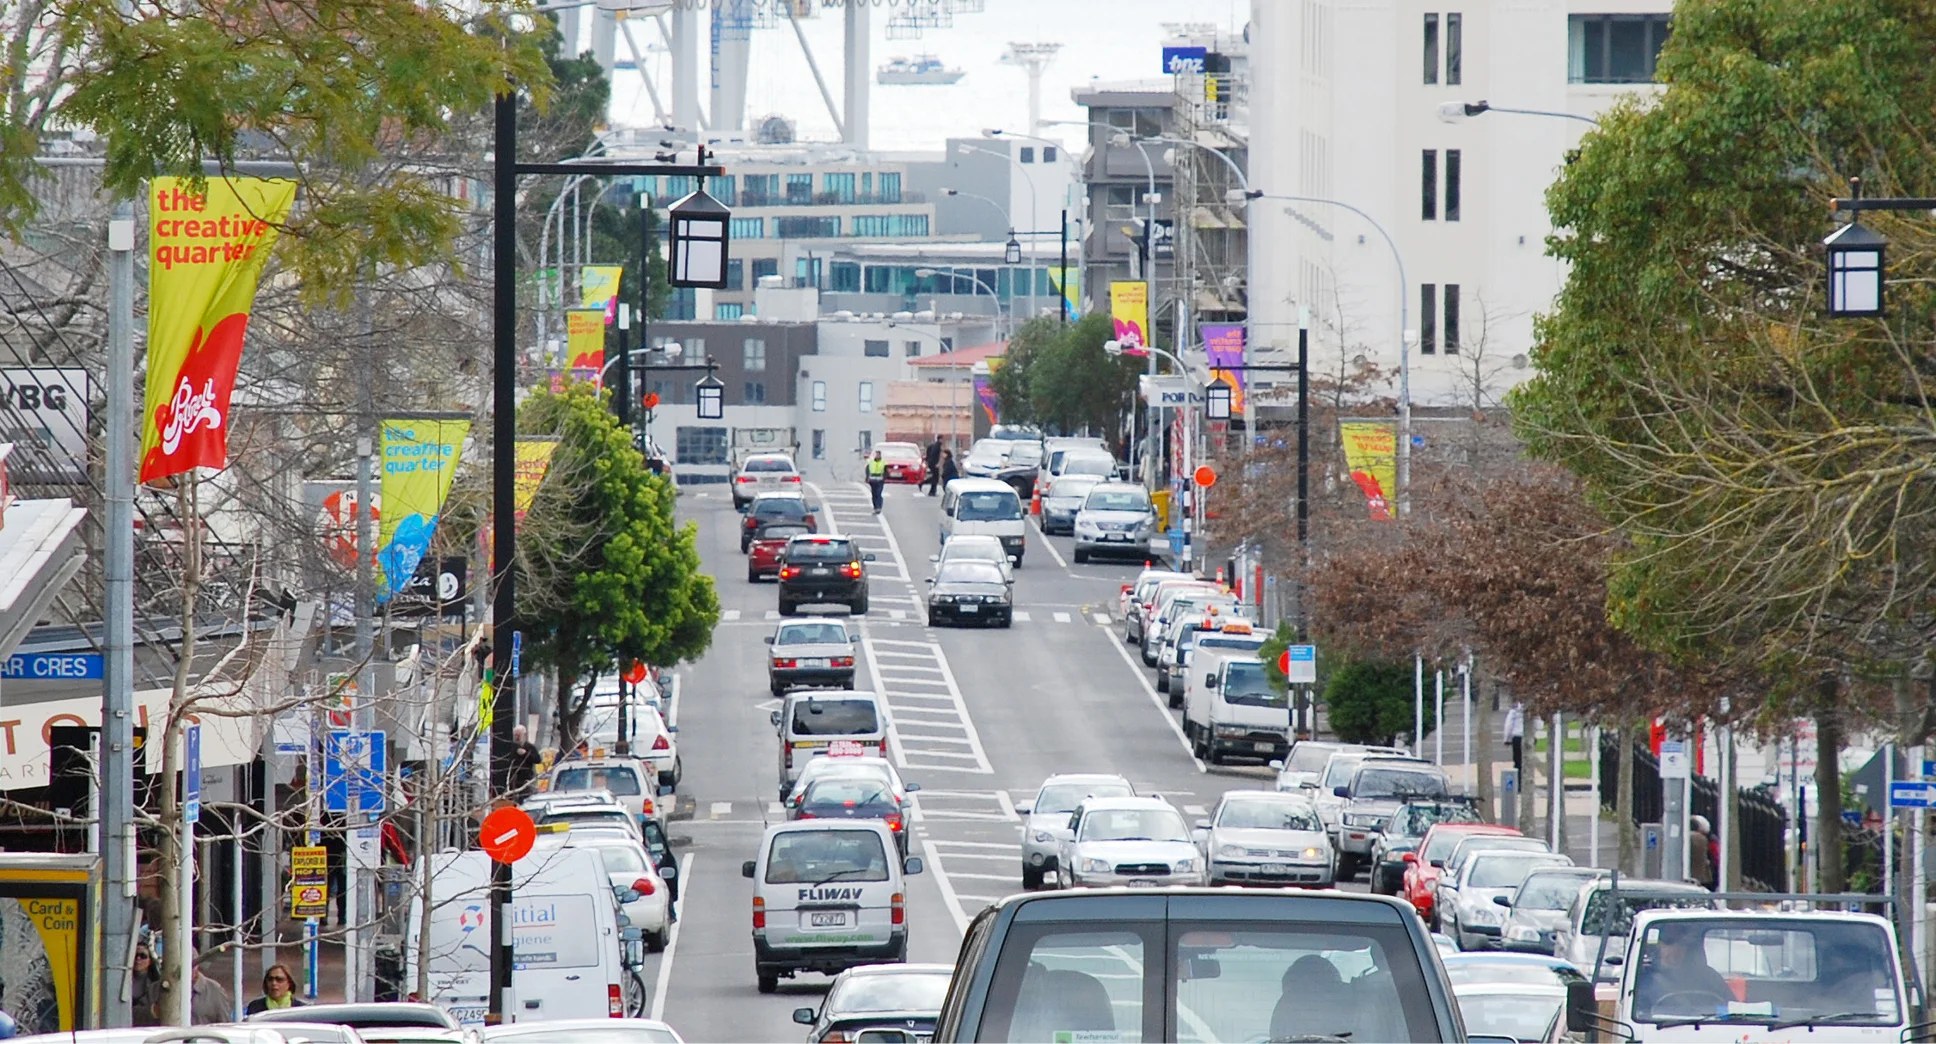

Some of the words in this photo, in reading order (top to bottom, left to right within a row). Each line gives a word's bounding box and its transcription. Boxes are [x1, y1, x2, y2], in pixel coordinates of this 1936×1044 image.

[157, 188, 206, 212] the
[156, 214, 270, 238] creative
[156, 242, 256, 270] quarter
[385, 426, 415, 441] the
[385, 440, 453, 457] creative
[385, 458, 447, 477] quarter
[33, 657, 87, 677] CRES
[29, 901, 62, 915] Card
[66, 905, 74, 915] &
[43, 916, 74, 930] Coin
